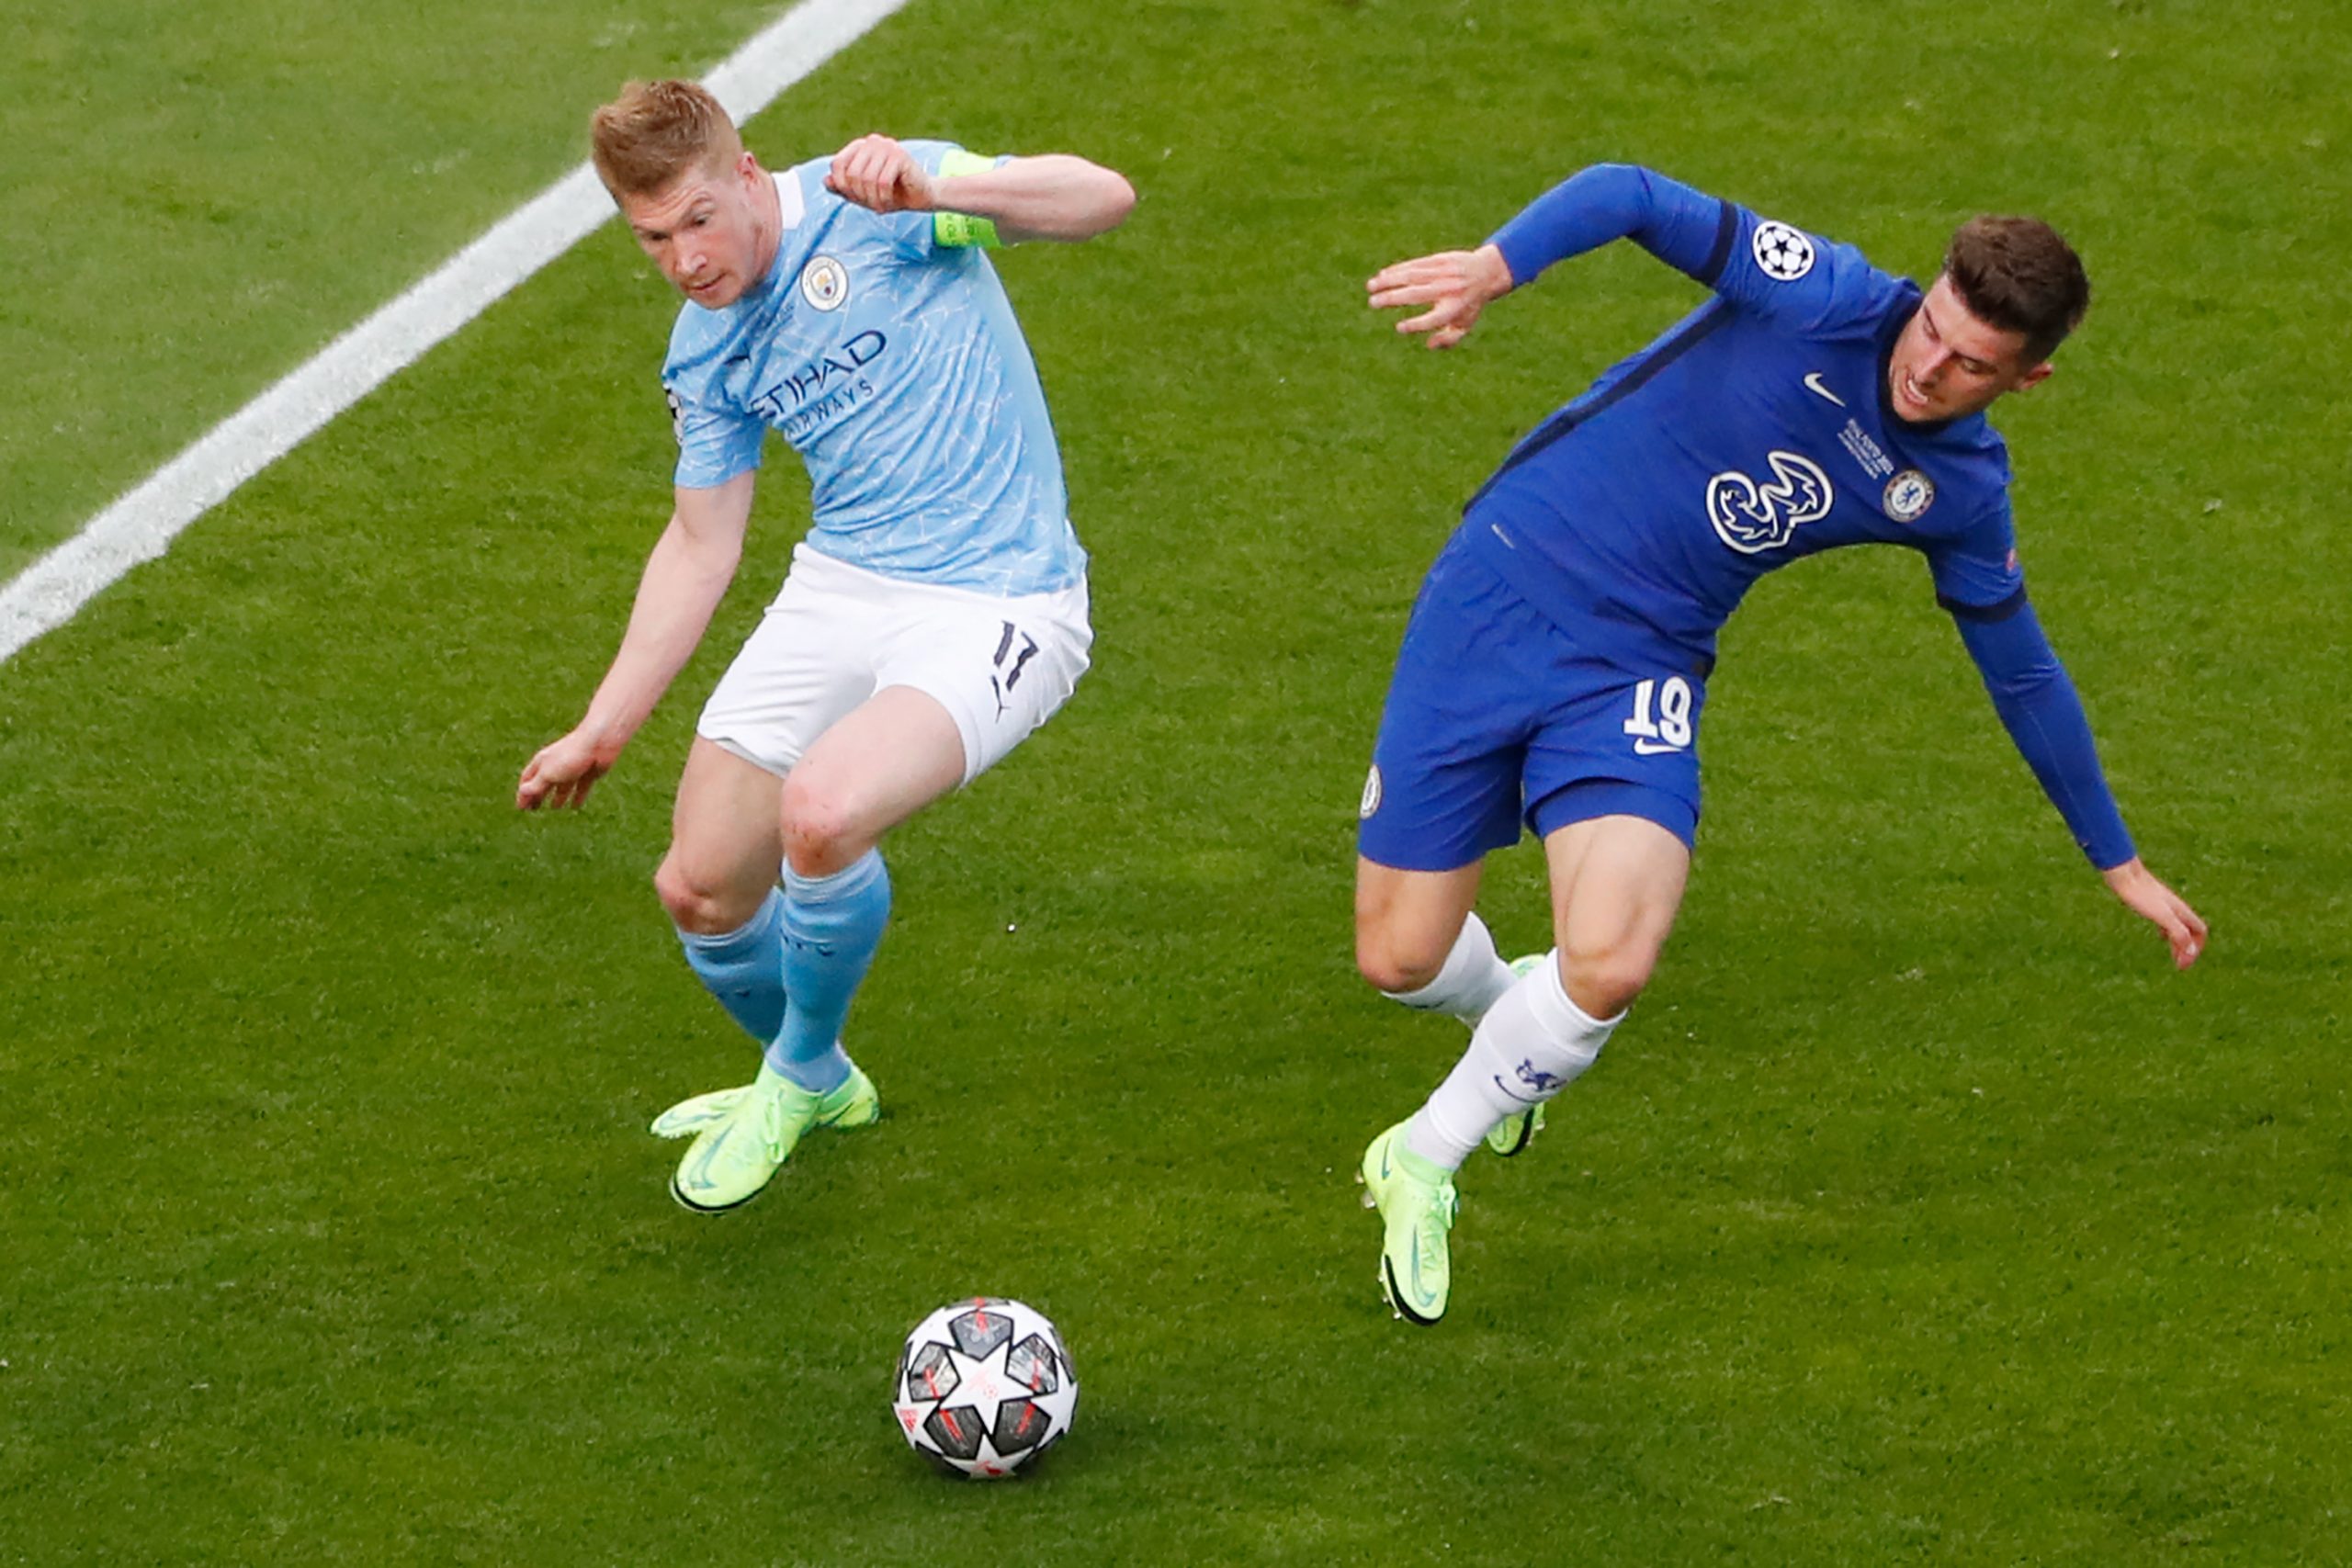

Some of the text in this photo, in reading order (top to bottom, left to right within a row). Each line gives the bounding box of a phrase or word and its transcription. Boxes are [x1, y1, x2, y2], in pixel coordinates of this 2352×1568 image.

[745, 330, 887, 420] ETIHAD
[784, 379, 874, 438] AIRWAYS
[993, 620, 1039, 693] 17
[1623, 676, 1691, 748] 19
